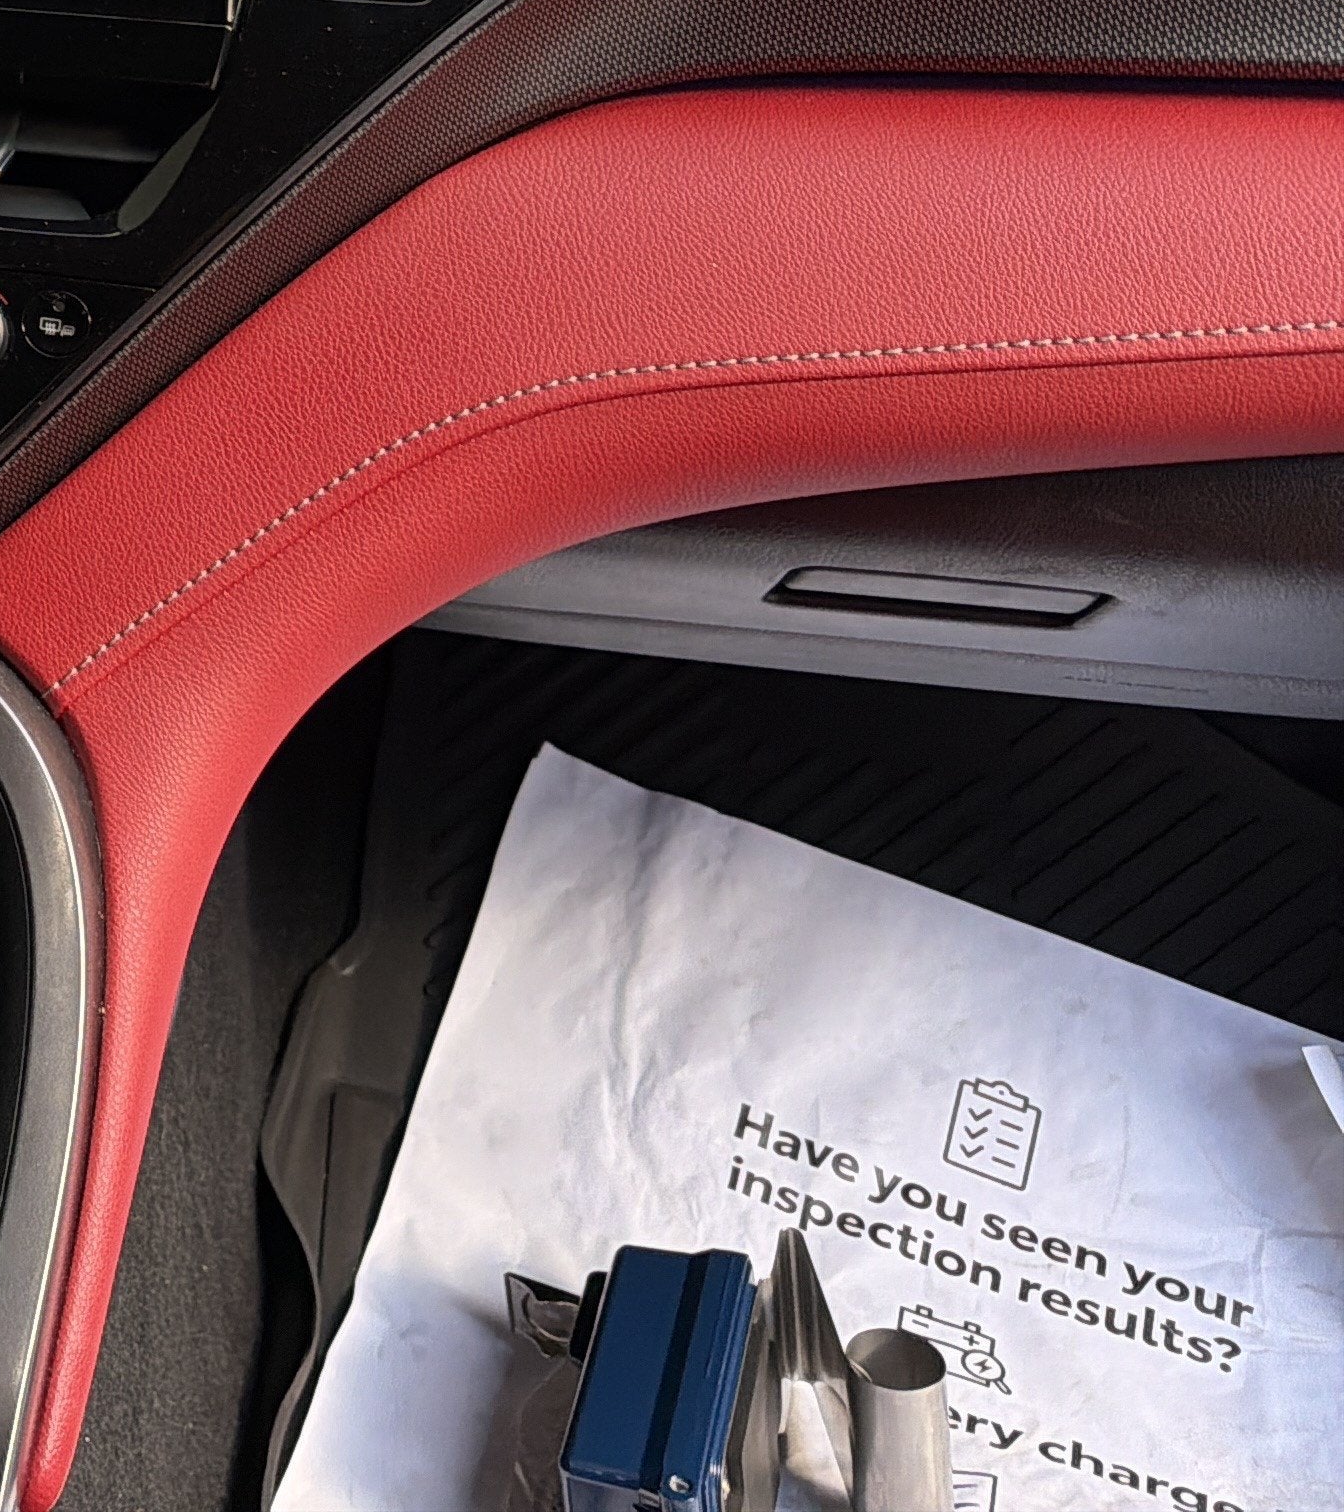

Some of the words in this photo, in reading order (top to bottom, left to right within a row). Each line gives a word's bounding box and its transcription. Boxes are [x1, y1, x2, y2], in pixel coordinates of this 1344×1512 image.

[728, 1155, 1002, 1294] inspection
[1018, 1277, 1242, 1374] results?
[733, 1103, 860, 1183] Have
[867, 1165, 968, 1227] you
[980, 1213, 1108, 1278] seen
[1121, 1260, 1255, 1328] your
